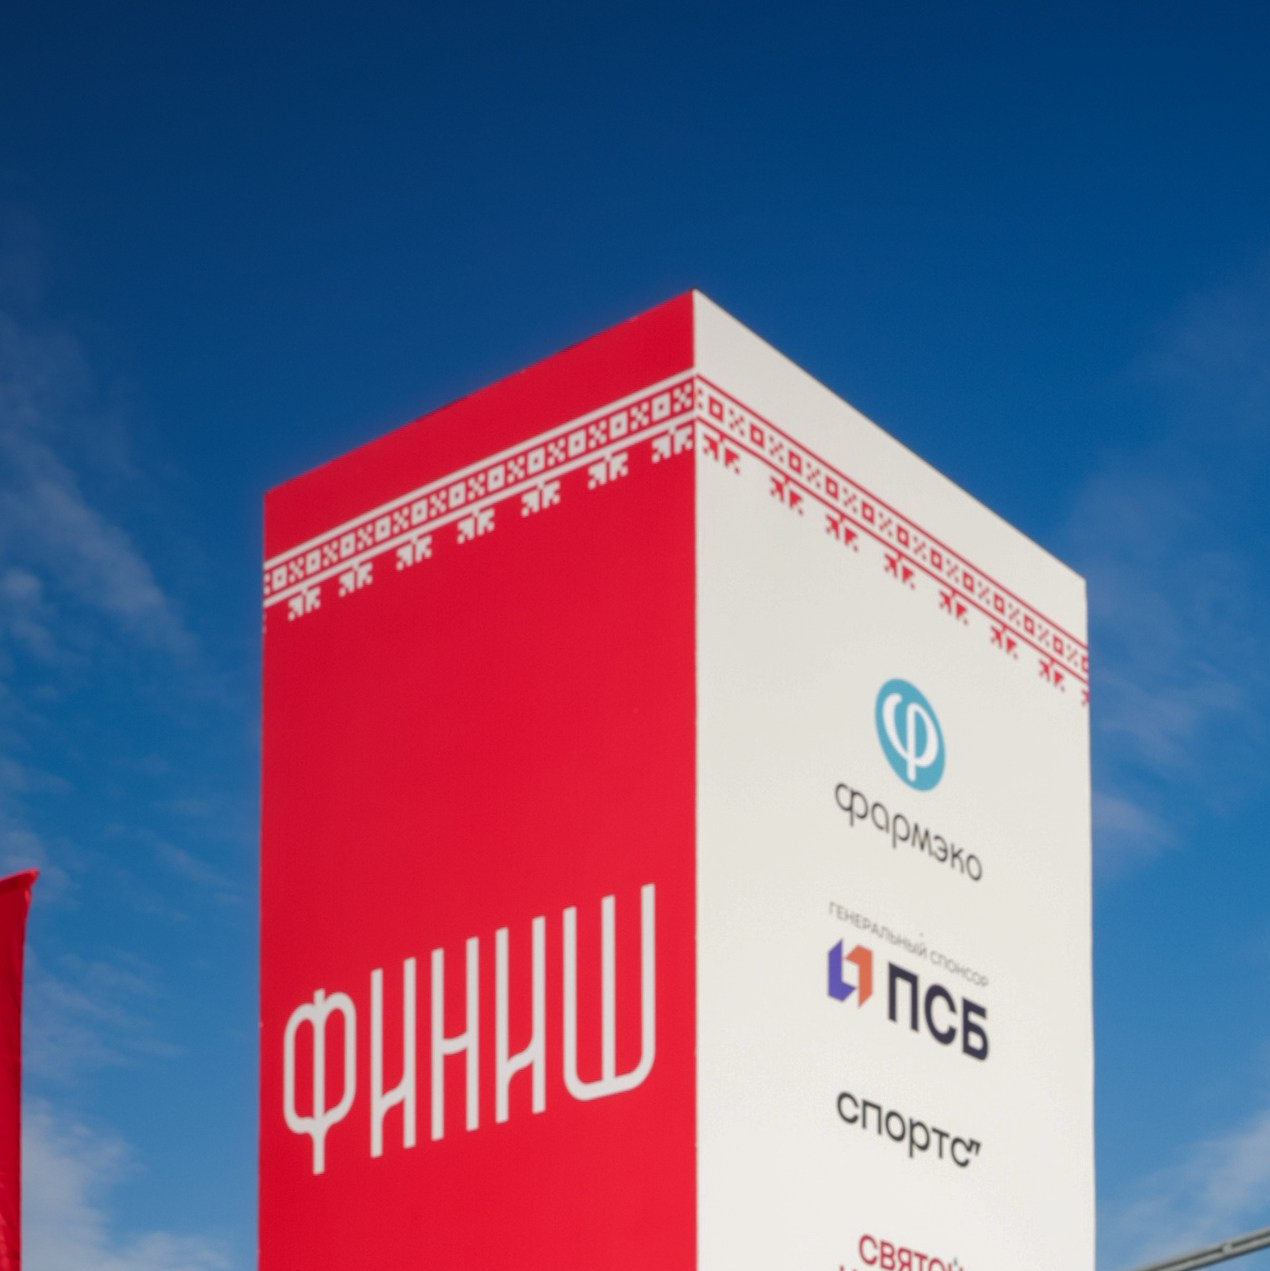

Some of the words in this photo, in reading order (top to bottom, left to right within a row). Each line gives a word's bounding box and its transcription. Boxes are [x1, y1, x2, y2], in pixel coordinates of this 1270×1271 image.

[834, 782, 982, 882] фармэко
[829, 901, 928, 959] ГЕНЕРАЛЬНЫЙ
[930, 950, 989, 988] СПОНСОР
[284, 883, 656, 1175] ФИНИШ
[888, 961, 989, 1062] ПСБ
